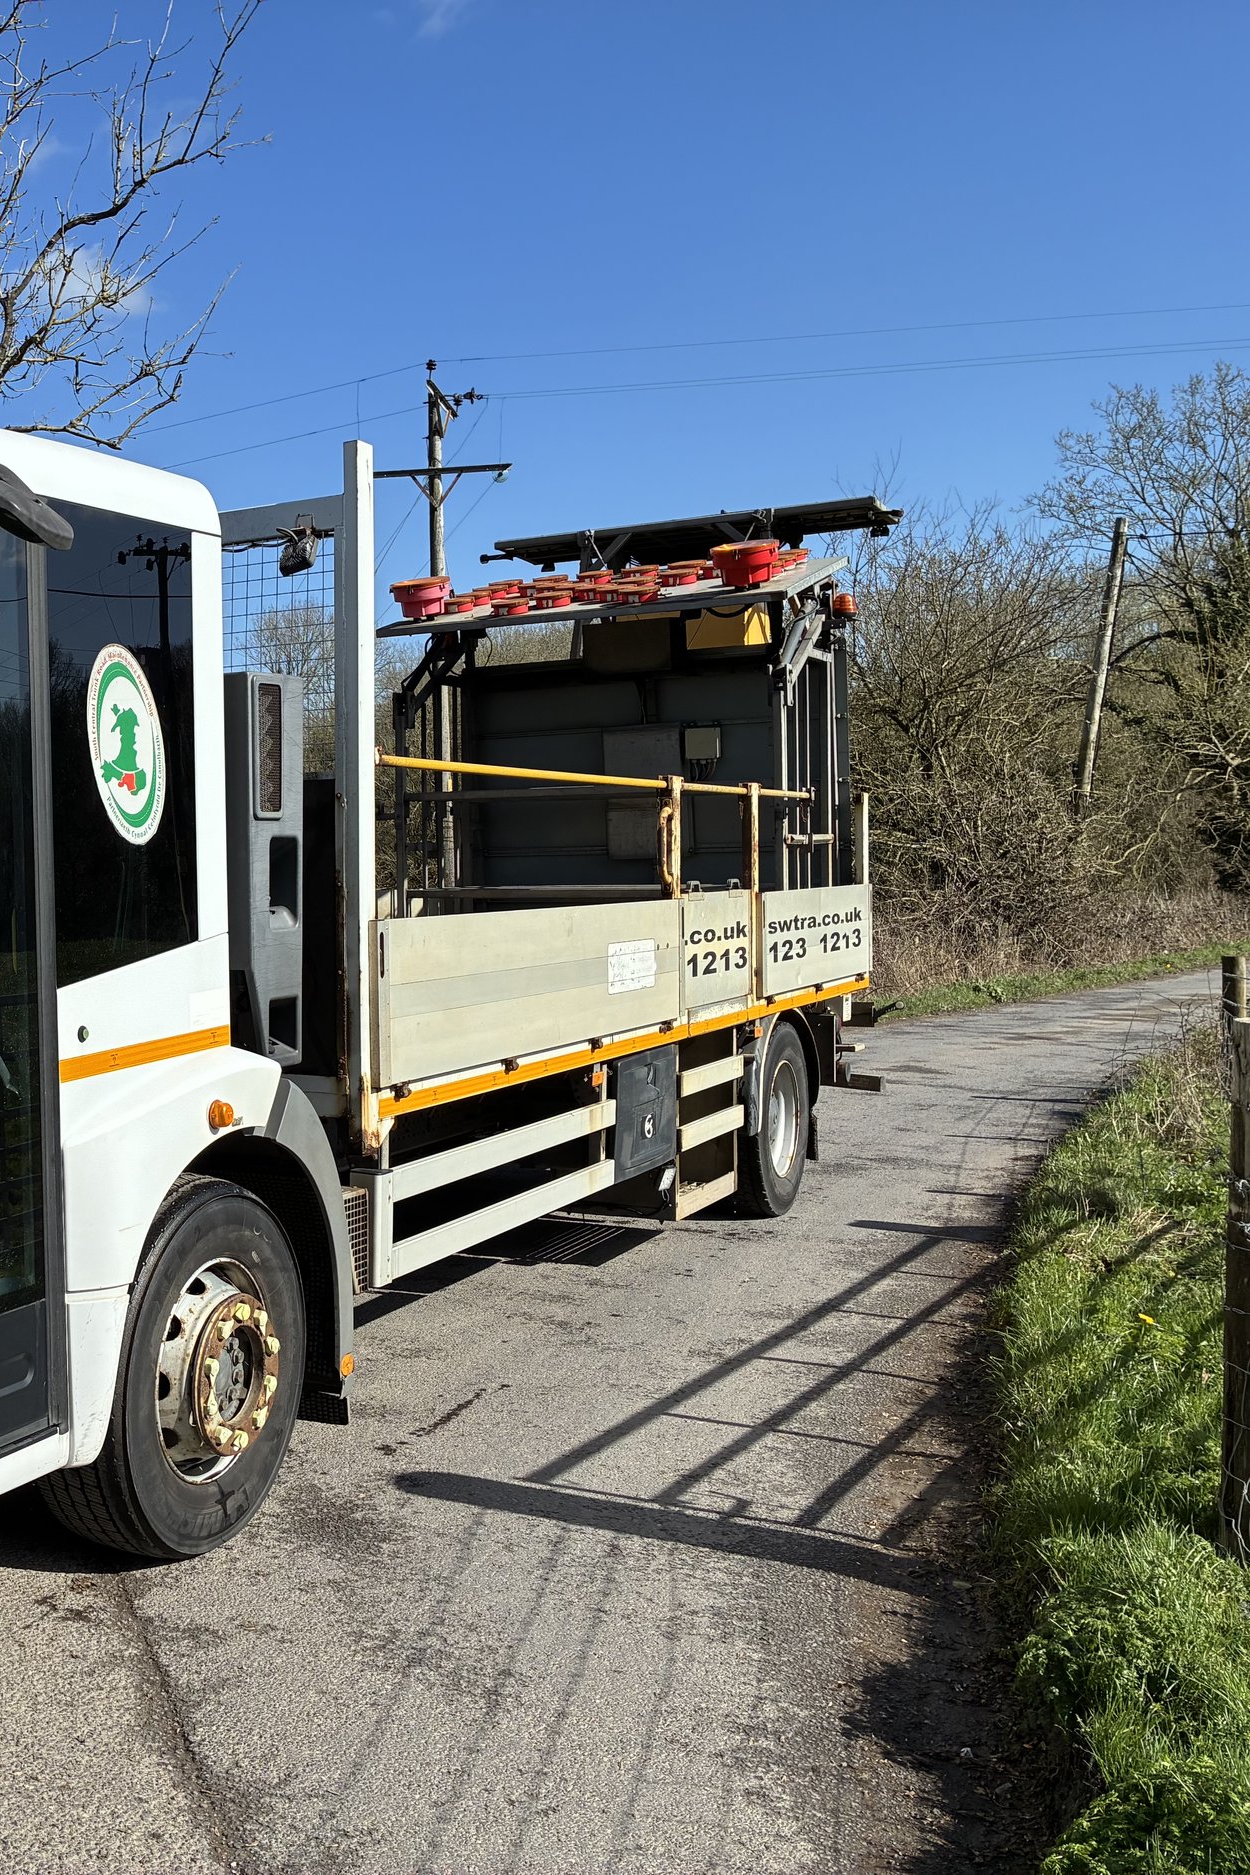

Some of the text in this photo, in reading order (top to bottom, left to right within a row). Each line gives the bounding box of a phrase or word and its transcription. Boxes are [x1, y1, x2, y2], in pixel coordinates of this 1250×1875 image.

[768, 907, 862, 935] swtra.co.uk
[687, 946, 748, 978] 1213
[769, 928, 862, 964] 123 1213
